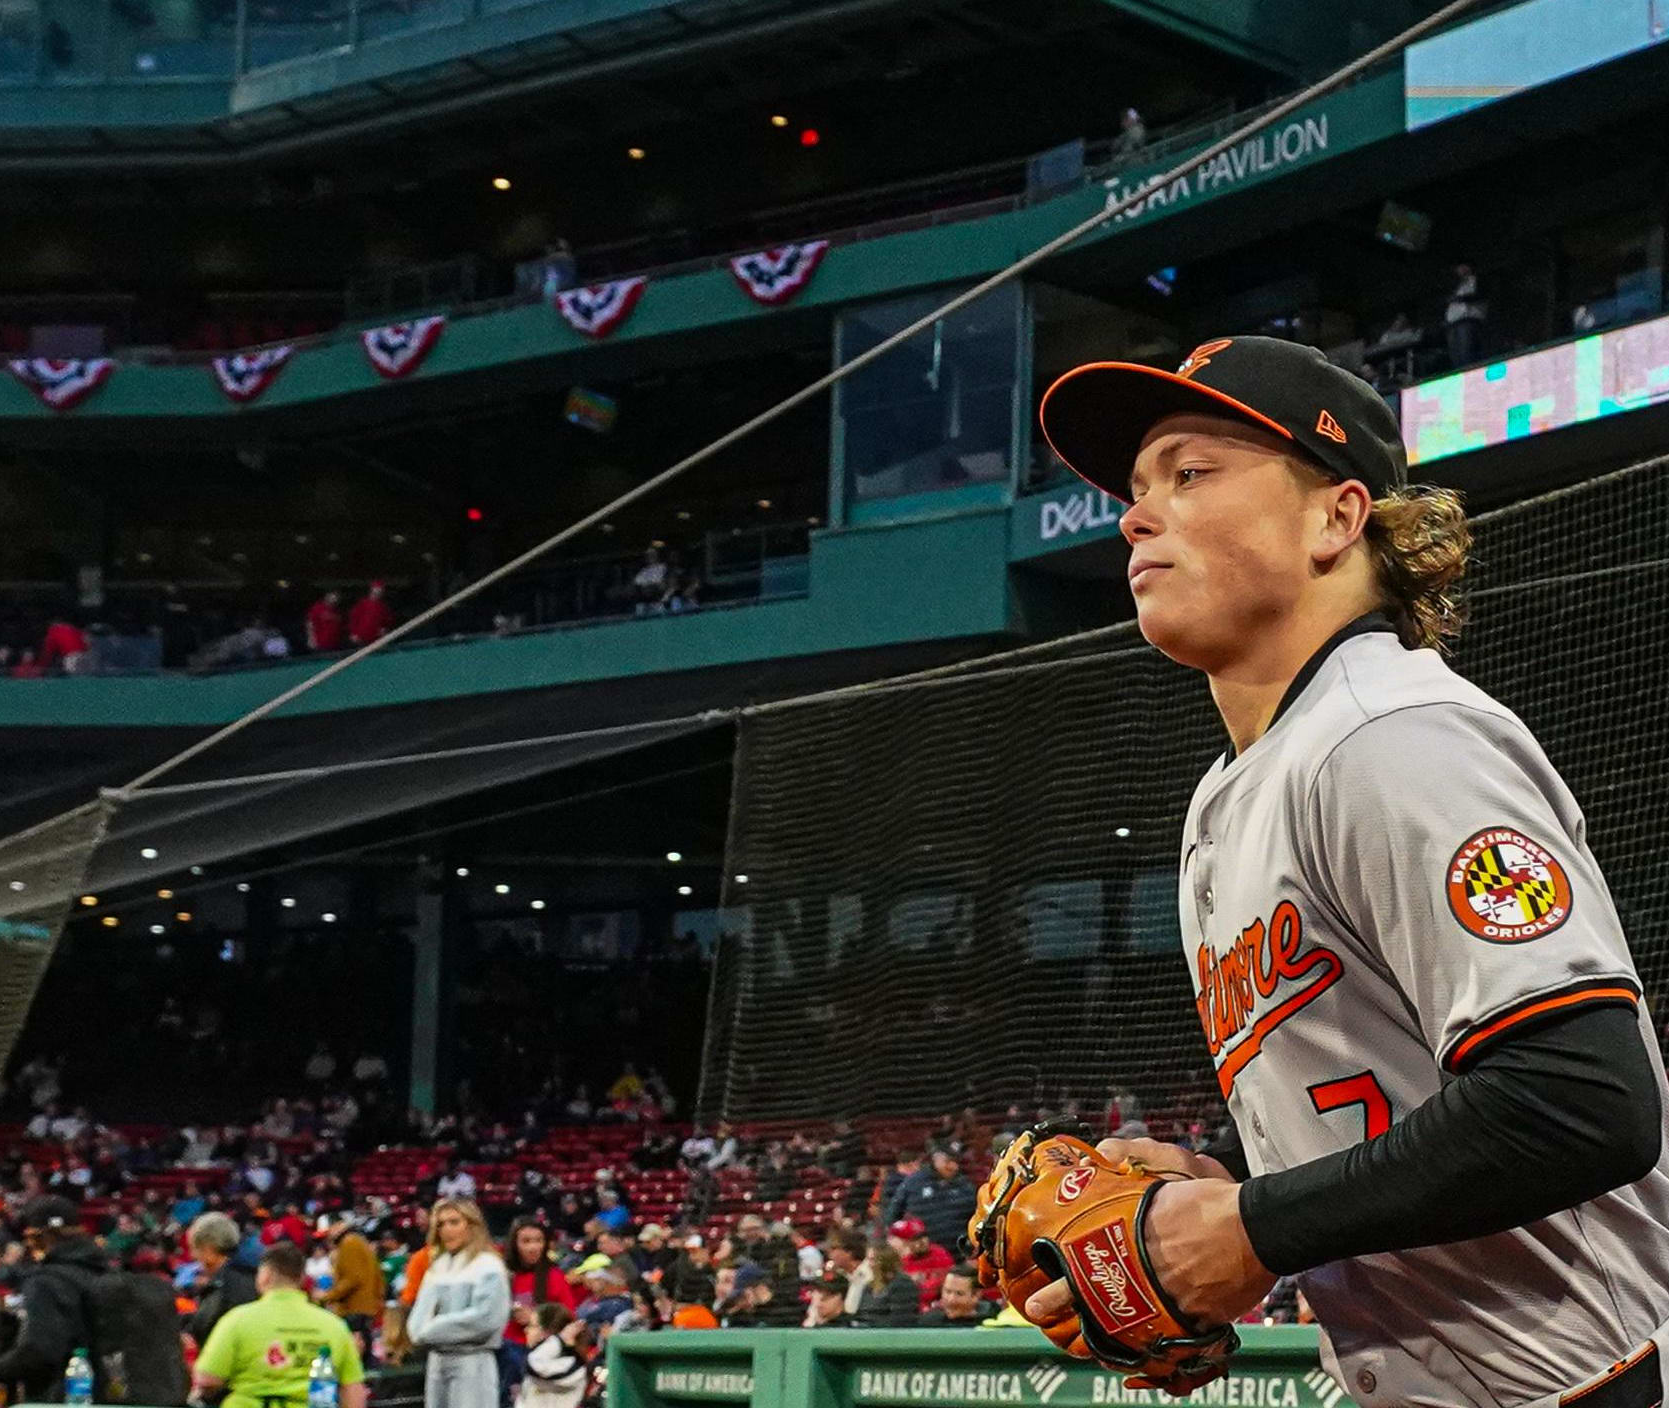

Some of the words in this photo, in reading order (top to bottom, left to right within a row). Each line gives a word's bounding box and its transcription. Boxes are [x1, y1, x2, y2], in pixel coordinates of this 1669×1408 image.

[1197, 112, 1330, 193] PAVILION
[1451, 831, 1553, 884] BALTIMORE
[1482, 906, 1565, 938] ORIOLES
[1305, 1069, 1394, 1142] 7
[1083, 1240, 1137, 1317] Rawlings
[859, 1371, 908, 1398] BANK
[914, 1373, 934, 1399] OF
[936, 1374, 1023, 1402] AMERICA
